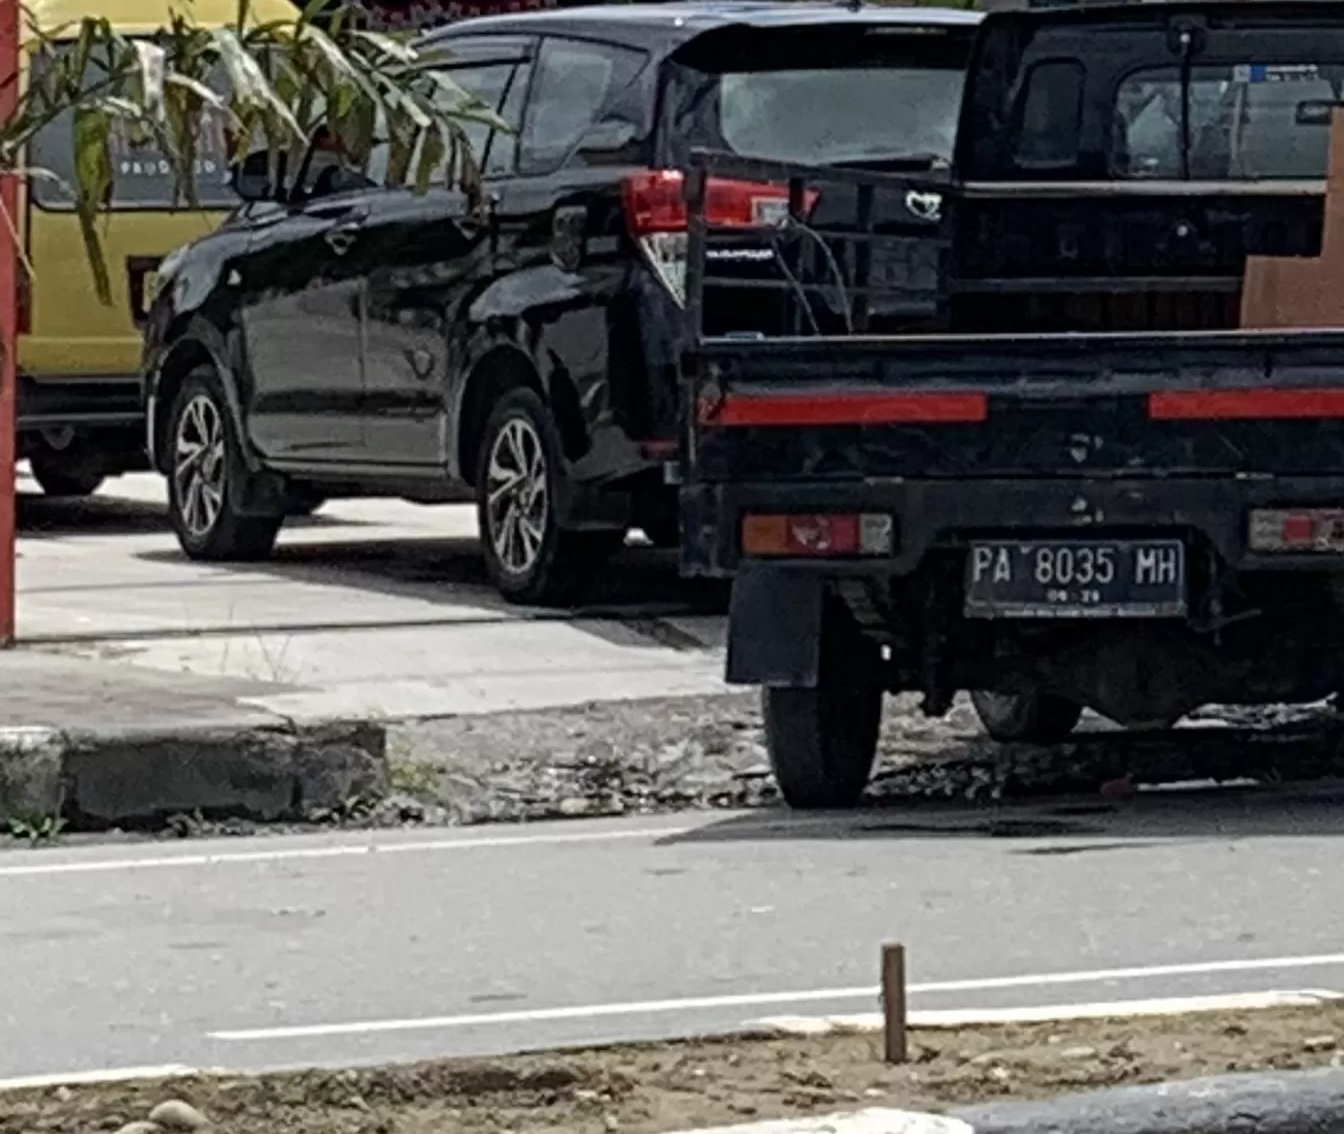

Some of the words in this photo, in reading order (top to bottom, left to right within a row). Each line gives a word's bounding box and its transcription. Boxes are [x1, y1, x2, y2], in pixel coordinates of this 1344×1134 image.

[973, 546, 1011, 584] PA
[1035, 547, 1114, 584] 8035
[1135, 548, 1176, 584] MH
